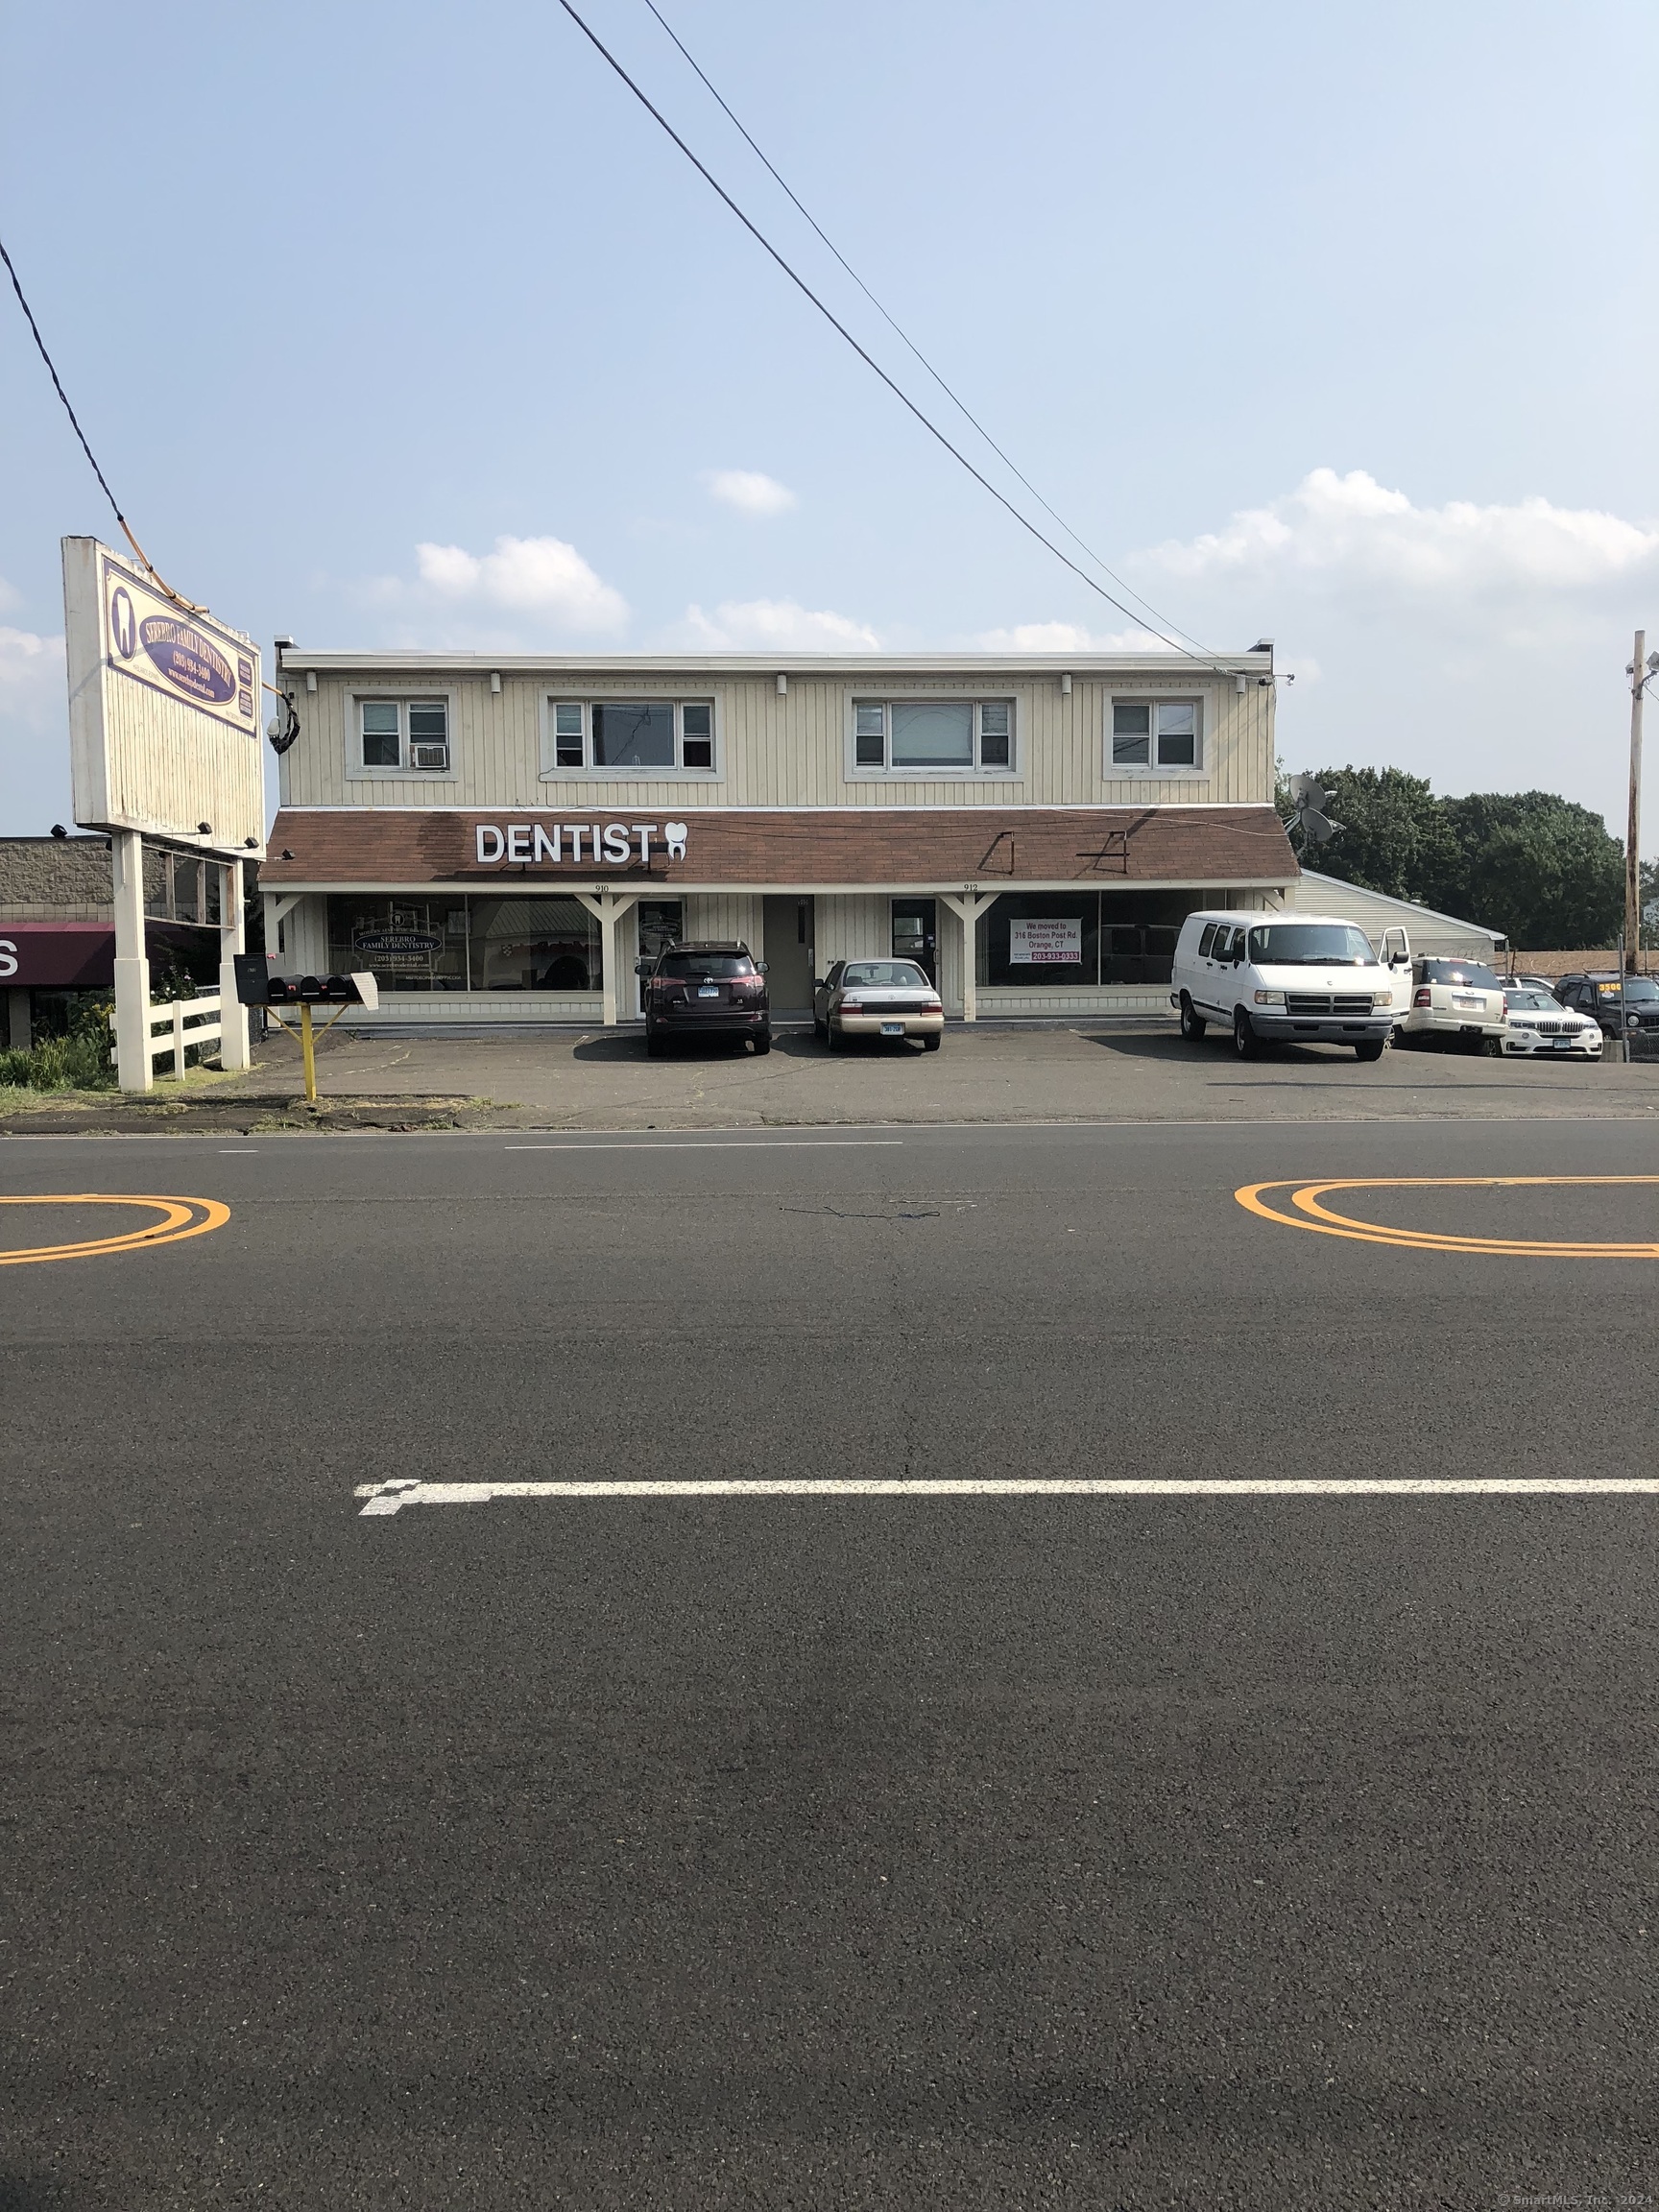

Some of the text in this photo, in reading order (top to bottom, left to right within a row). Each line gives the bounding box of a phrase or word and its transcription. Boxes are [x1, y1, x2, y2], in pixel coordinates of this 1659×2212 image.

[145, 622, 176, 644] SEREBRO
[176, 625, 199, 654] FAMILY
[199, 640, 232, 688] DENTISTRY
[476, 822, 659, 863] DENTIST
[1028, 941, 1054, 950] Orange,
